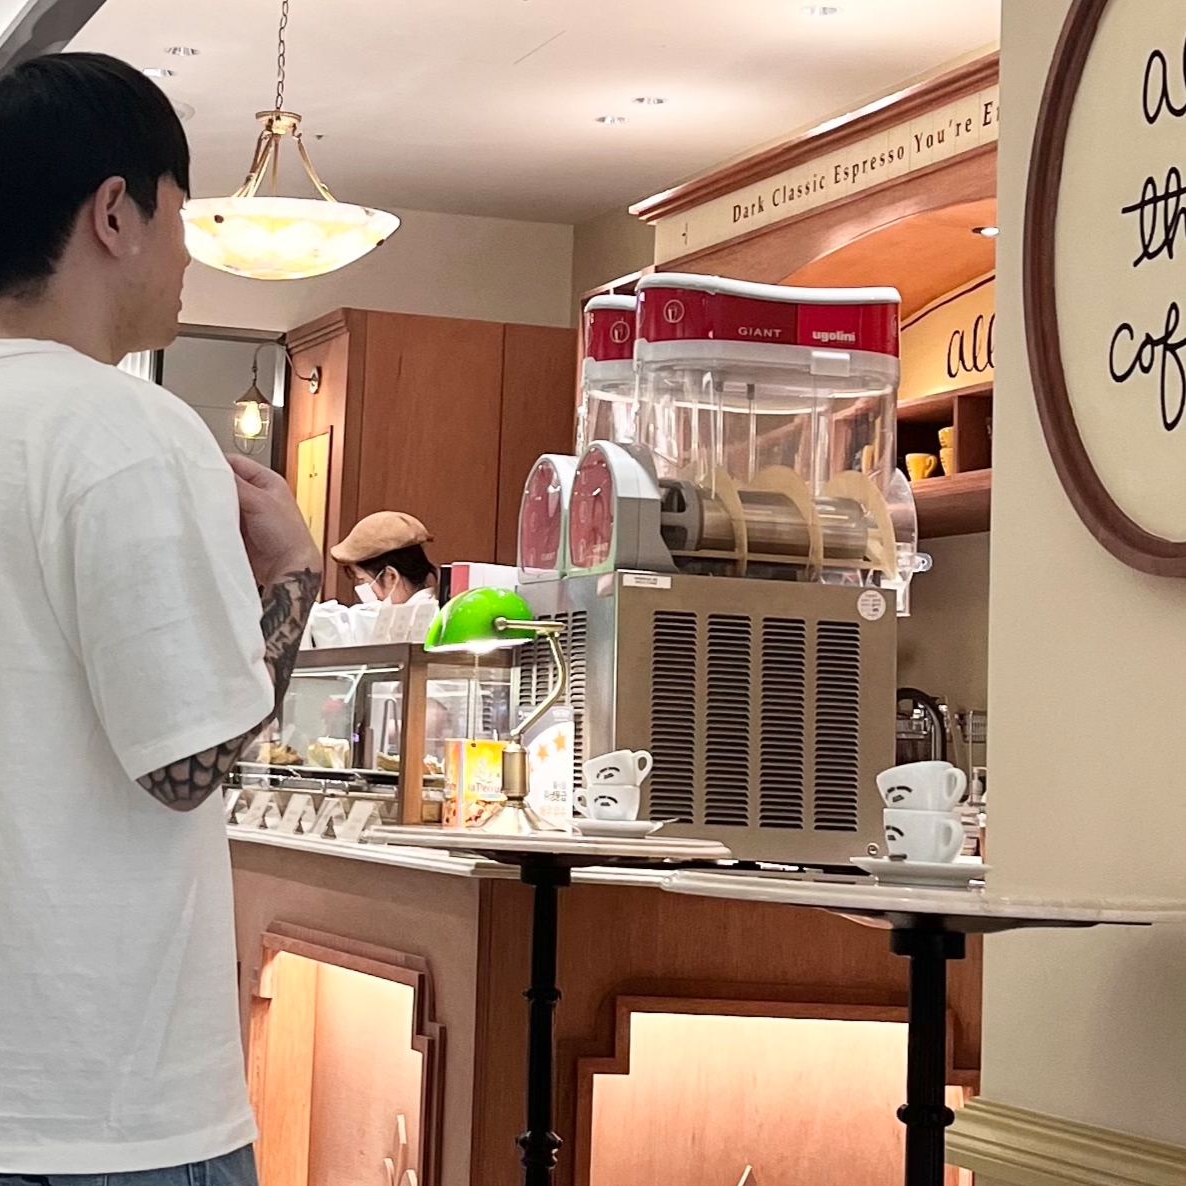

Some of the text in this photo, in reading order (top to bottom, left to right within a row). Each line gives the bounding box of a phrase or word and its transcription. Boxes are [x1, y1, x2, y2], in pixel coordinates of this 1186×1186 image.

[732, 195, 765, 223] Dark
[771, 173, 826, 207] Classic
[833, 144, 905, 184] Espresso
[914, 118, 973, 154] You're
[738, 326, 782, 338] GIANT
[812, 330, 856, 343] ugolini
[1109, 302, 1186, 432] cof
